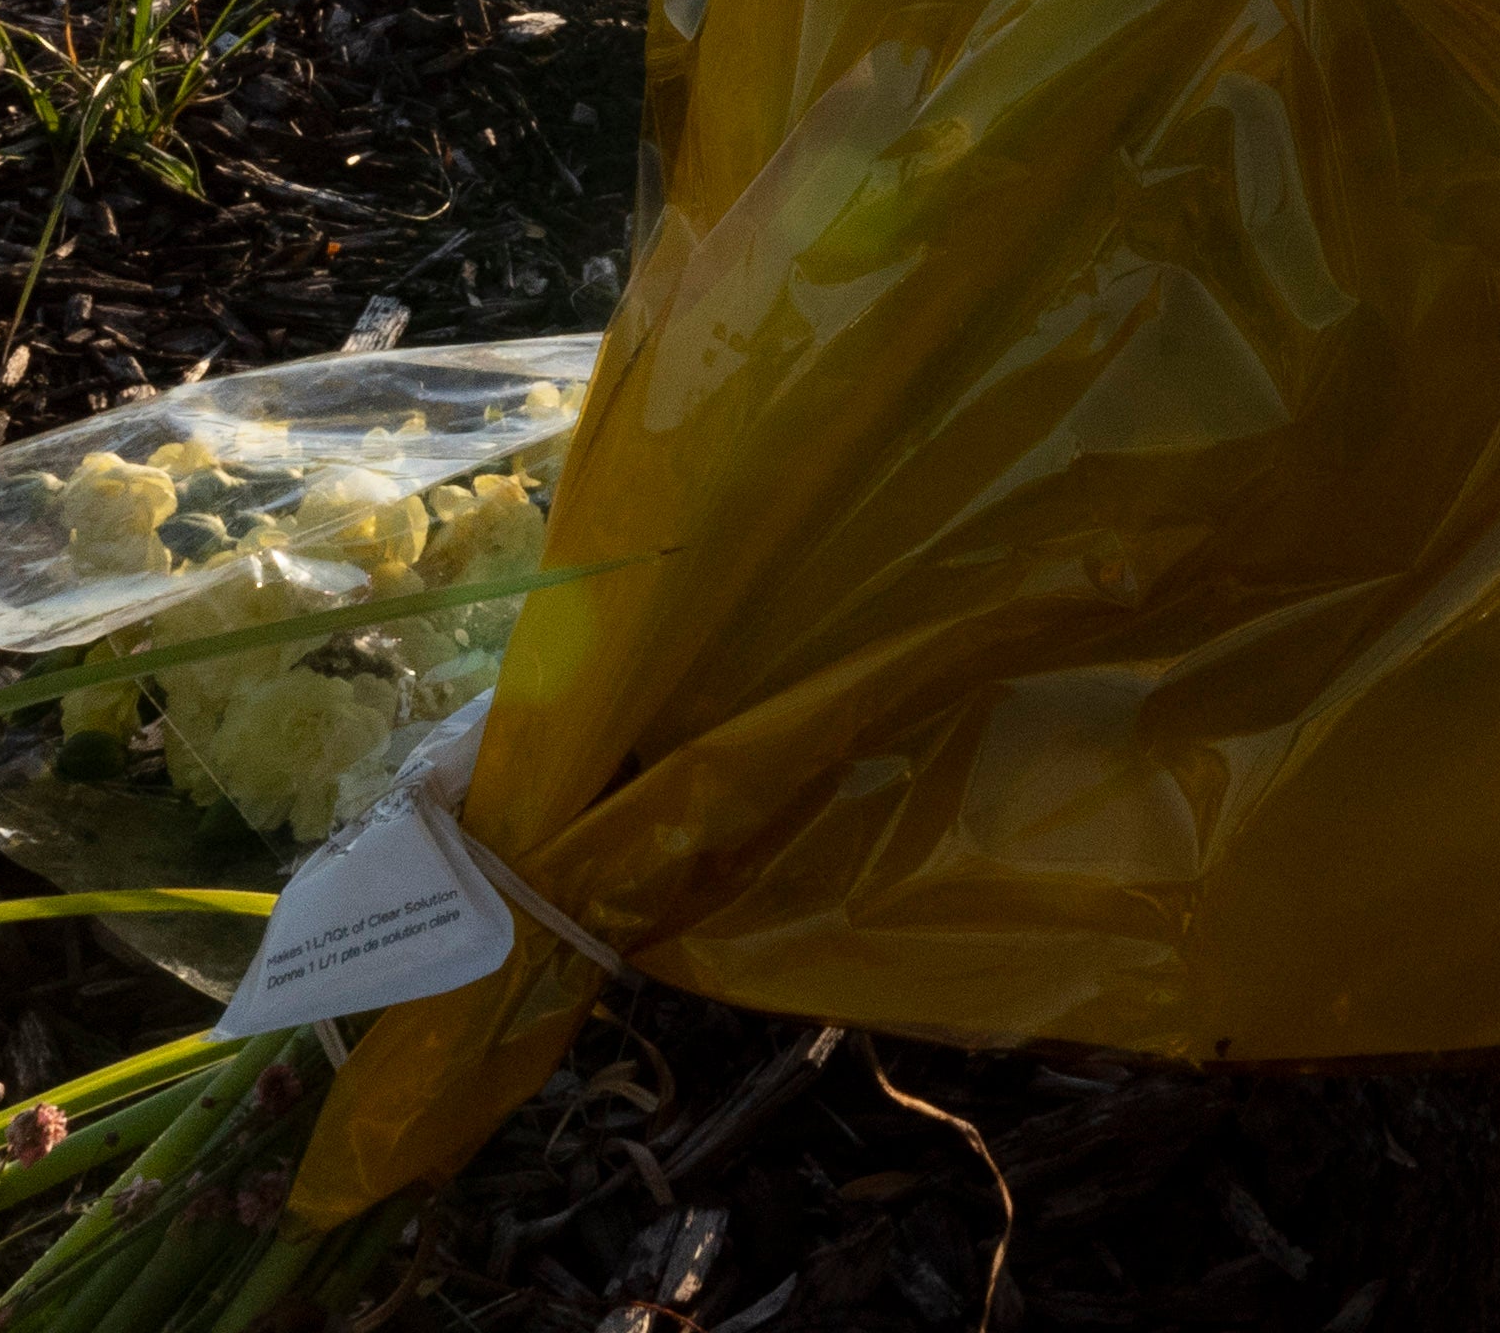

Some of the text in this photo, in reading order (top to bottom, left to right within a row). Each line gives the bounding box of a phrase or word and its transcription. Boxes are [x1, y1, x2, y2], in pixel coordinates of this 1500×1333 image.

[351, 918, 366, 935] of
[368, 907, 401, 928] Clear
[403, 889, 458, 915] Solution
[267, 967, 305, 990] Donne
[363, 937, 379, 954] de
[381, 921, 428, 948] solution
